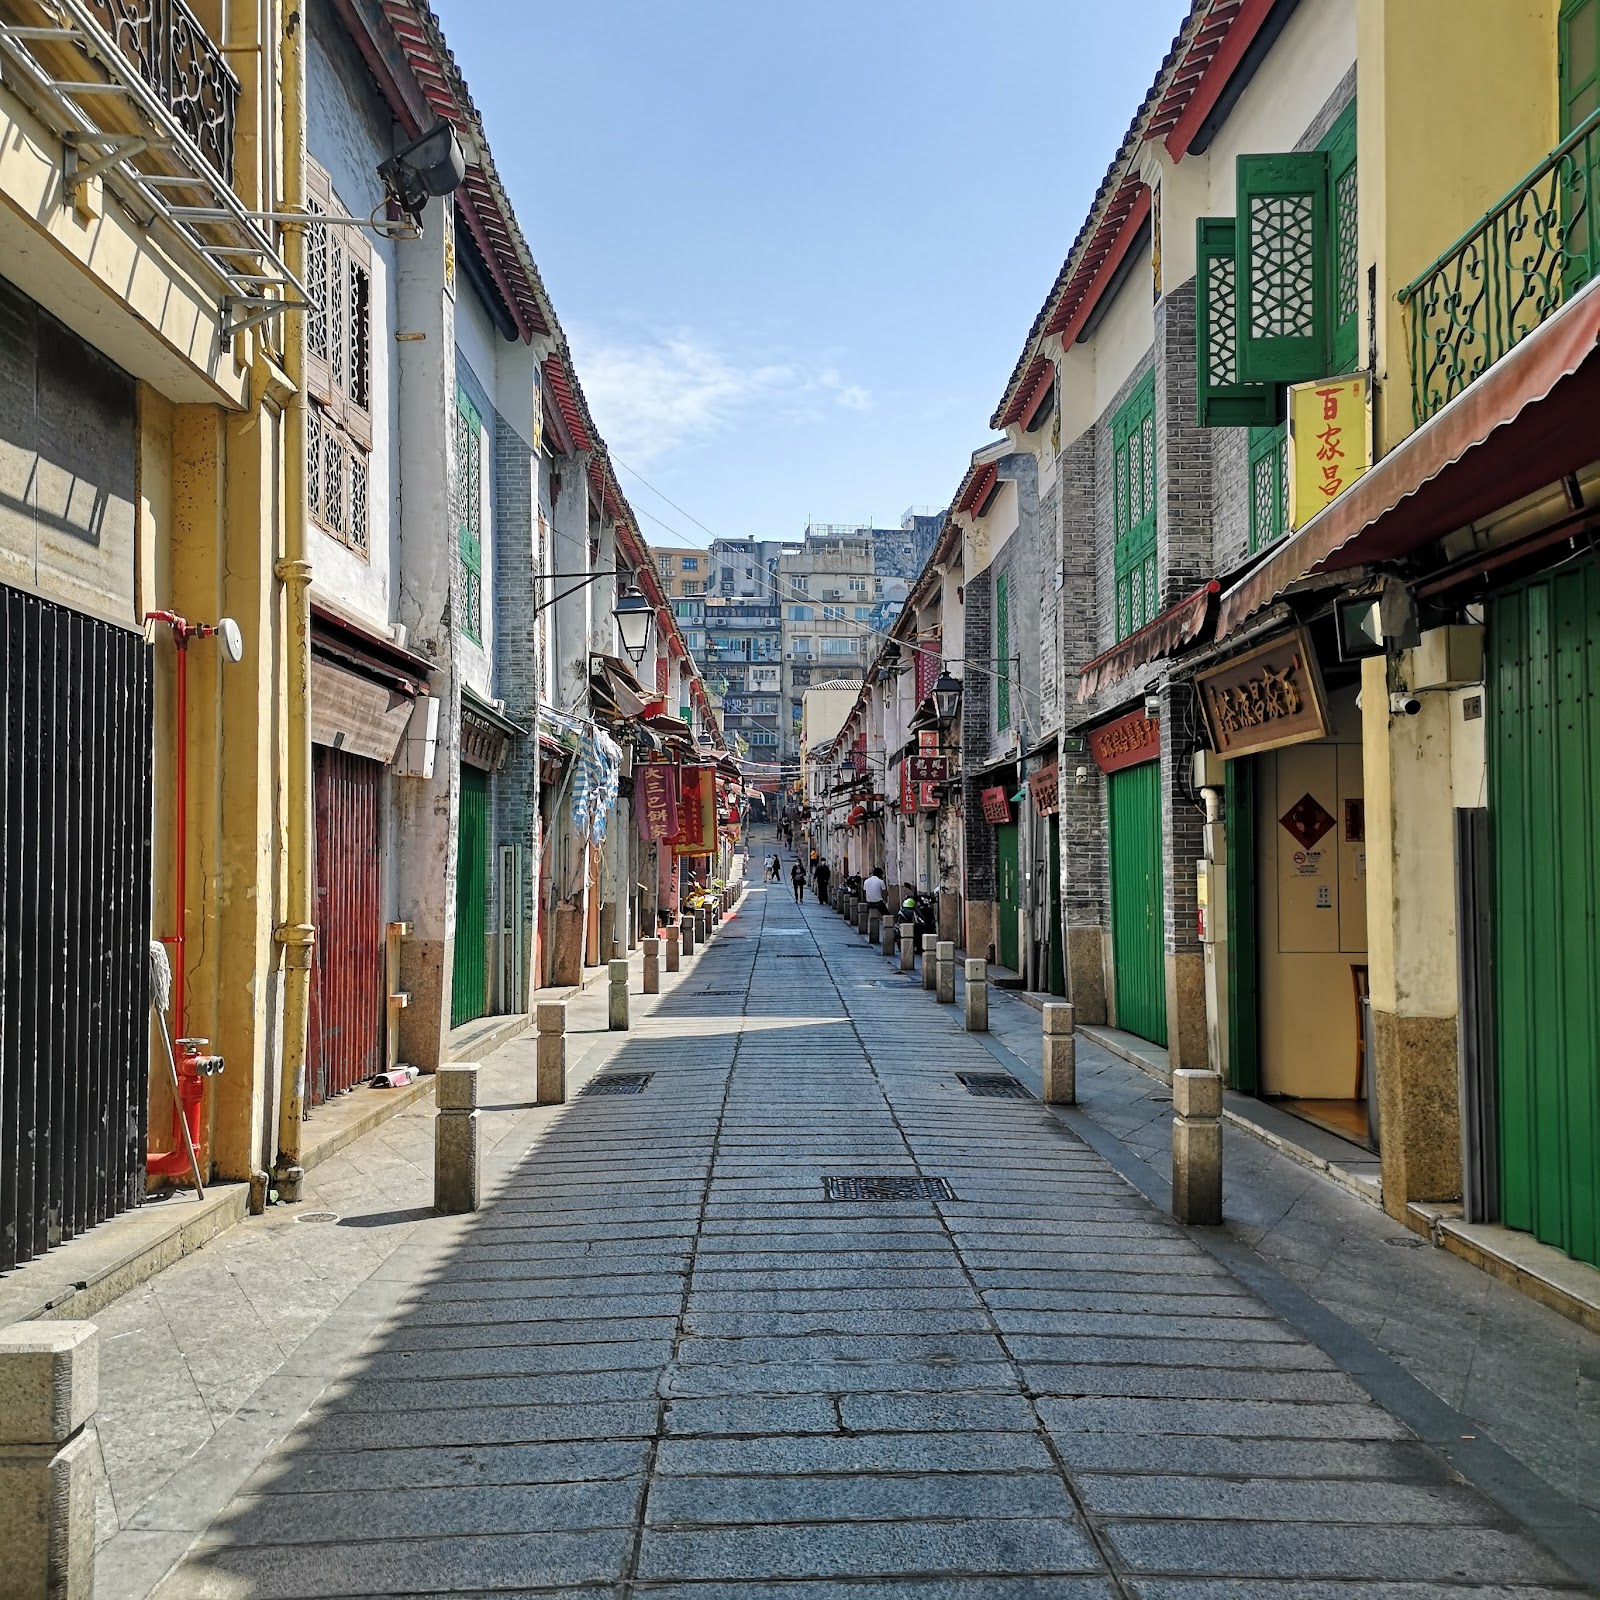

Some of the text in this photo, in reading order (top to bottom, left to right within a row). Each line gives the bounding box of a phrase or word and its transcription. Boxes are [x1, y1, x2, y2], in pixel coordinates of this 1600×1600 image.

[1315, 387, 1345, 496] 百家昌
[645, 767, 669, 837] 大三巴餅家
